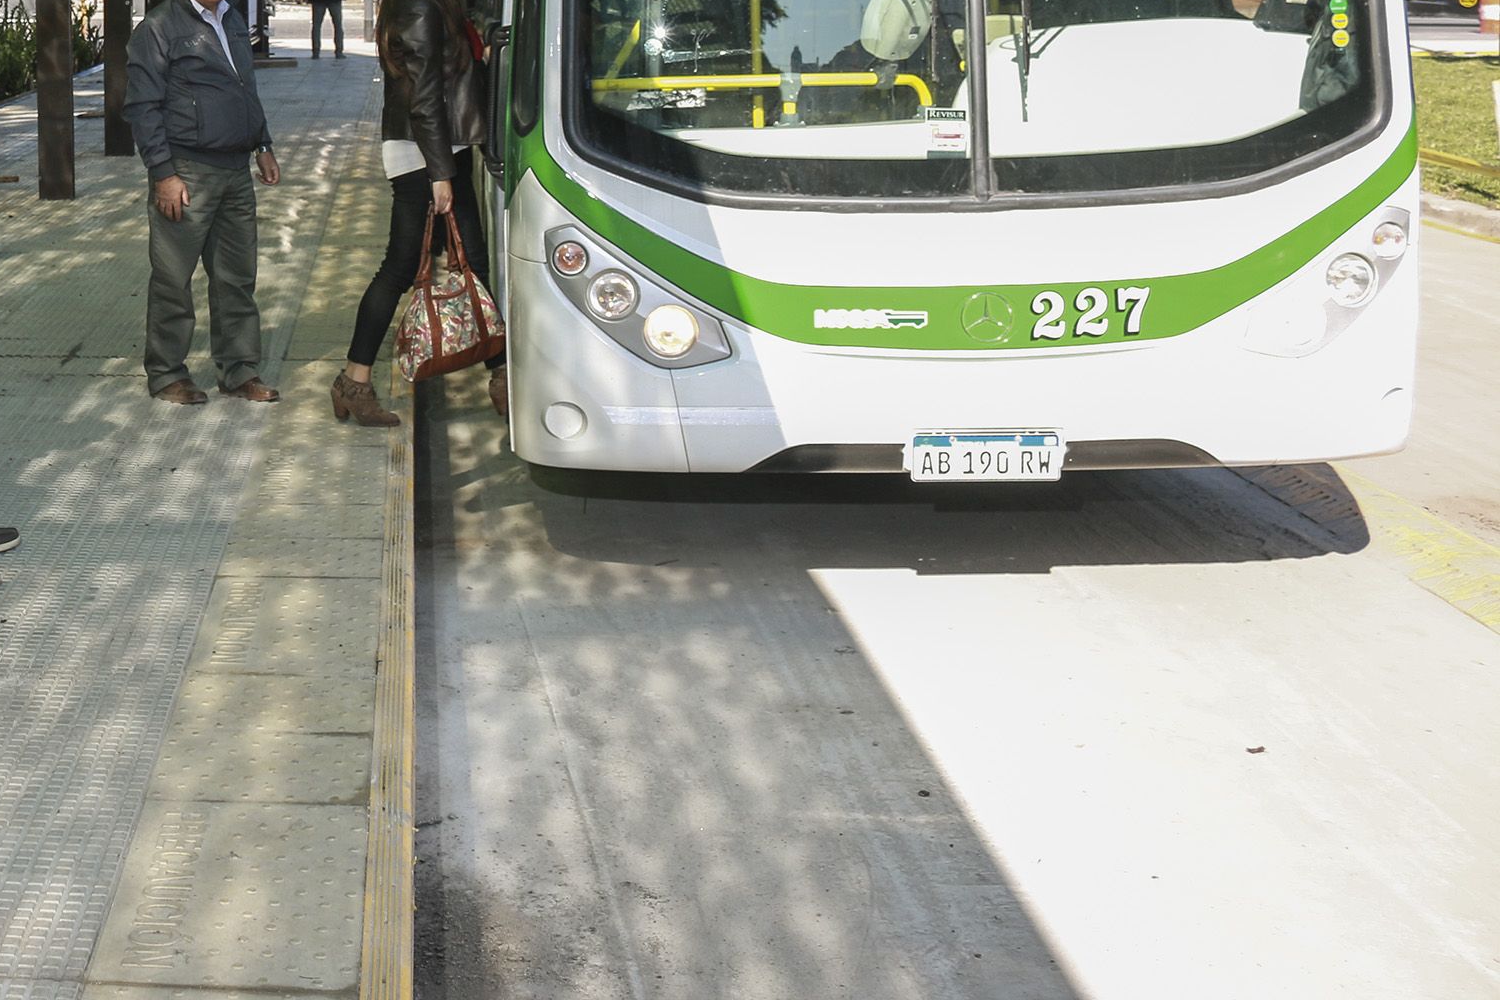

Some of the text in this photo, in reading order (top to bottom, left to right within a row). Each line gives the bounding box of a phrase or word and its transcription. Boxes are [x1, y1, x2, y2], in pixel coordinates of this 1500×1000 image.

[1031, 286, 1151, 340] 227
[921, 451, 1051, 475] AB 190 RW
